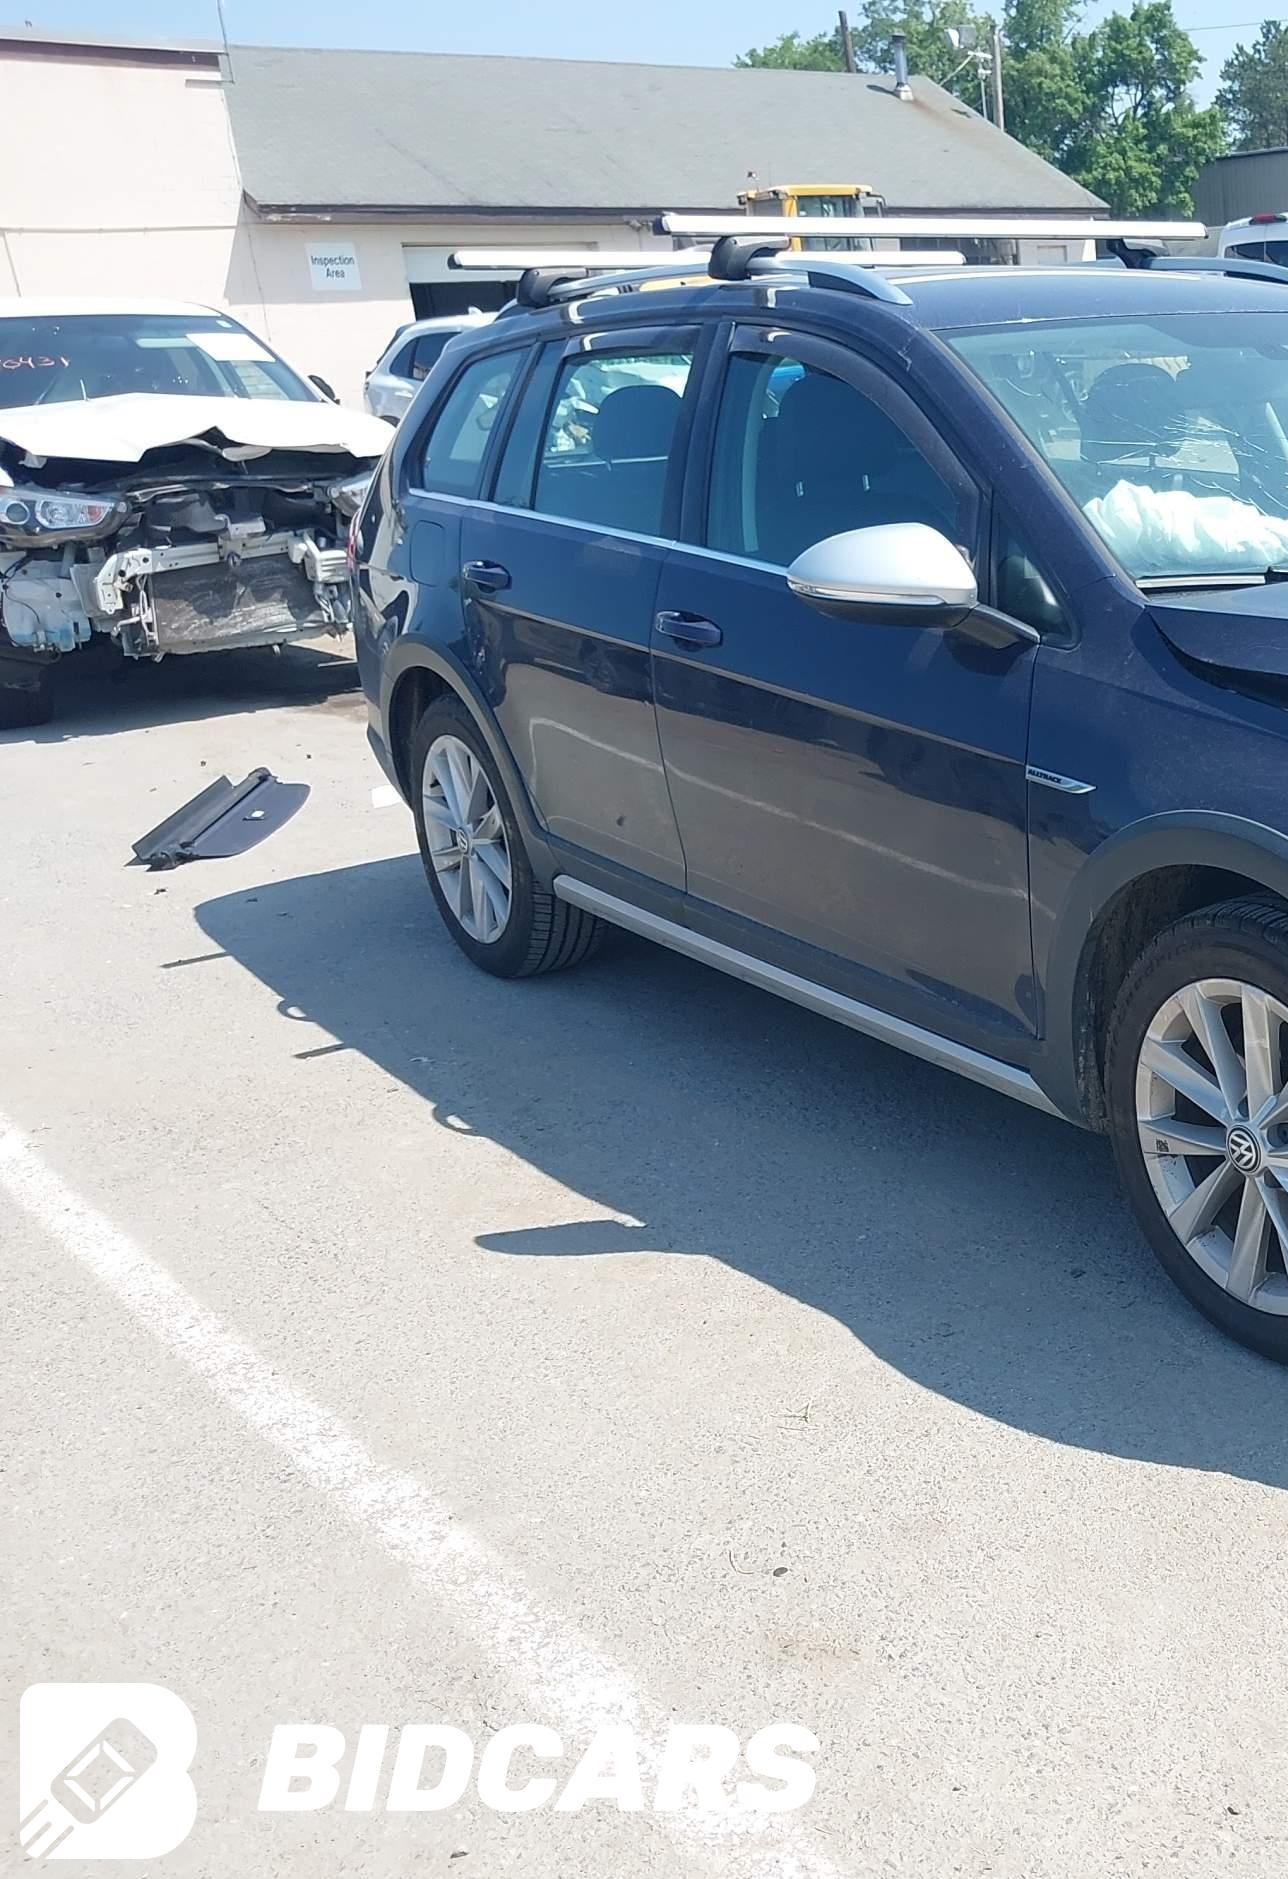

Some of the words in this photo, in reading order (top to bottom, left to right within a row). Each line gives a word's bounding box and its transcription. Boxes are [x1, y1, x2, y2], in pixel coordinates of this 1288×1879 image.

[311, 255, 355, 267] Inspection
[326, 267, 345, 278] Area
[1027, 768, 1062, 785] ALLTRACK
